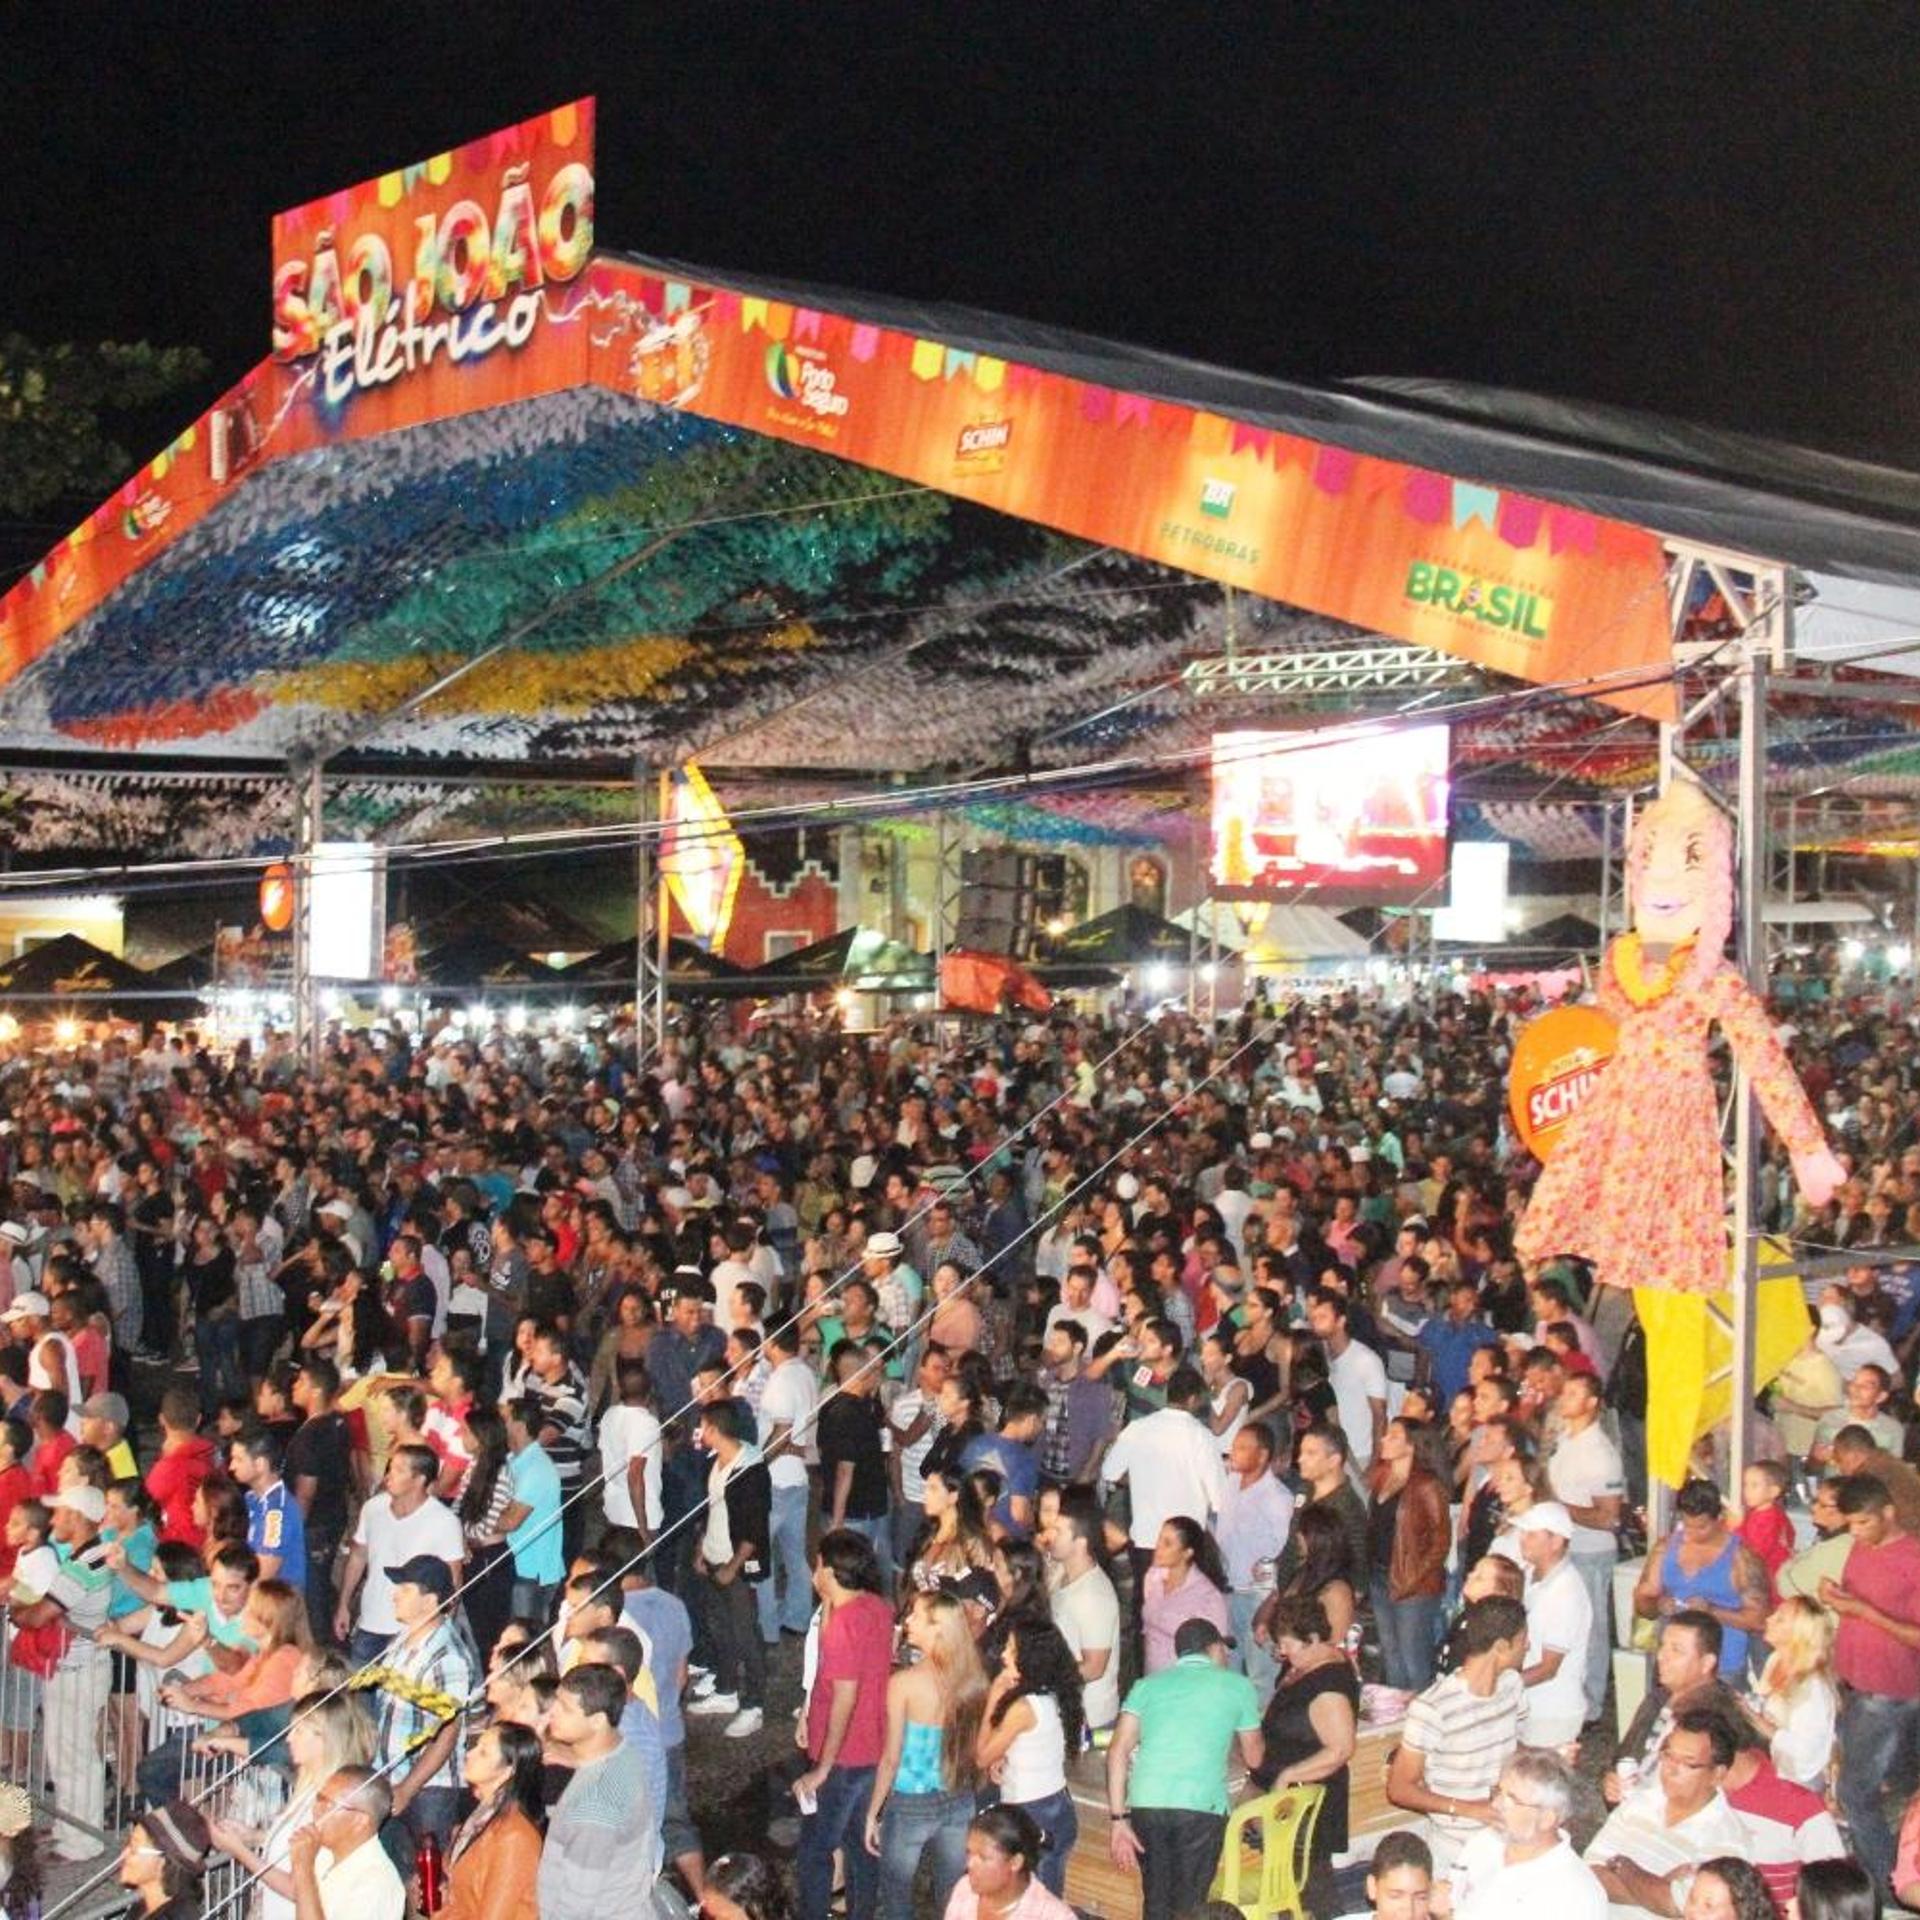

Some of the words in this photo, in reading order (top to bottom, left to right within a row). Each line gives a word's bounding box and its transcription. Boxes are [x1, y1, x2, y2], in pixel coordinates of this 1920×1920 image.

[273, 224, 393, 363] SÃO
[414, 162, 594, 322] JOÃO
[322, 282, 544, 401] Elétrico
[1160, 521, 1260, 564] PETROBRAS
[1405, 561, 1547, 639] BRASIL
